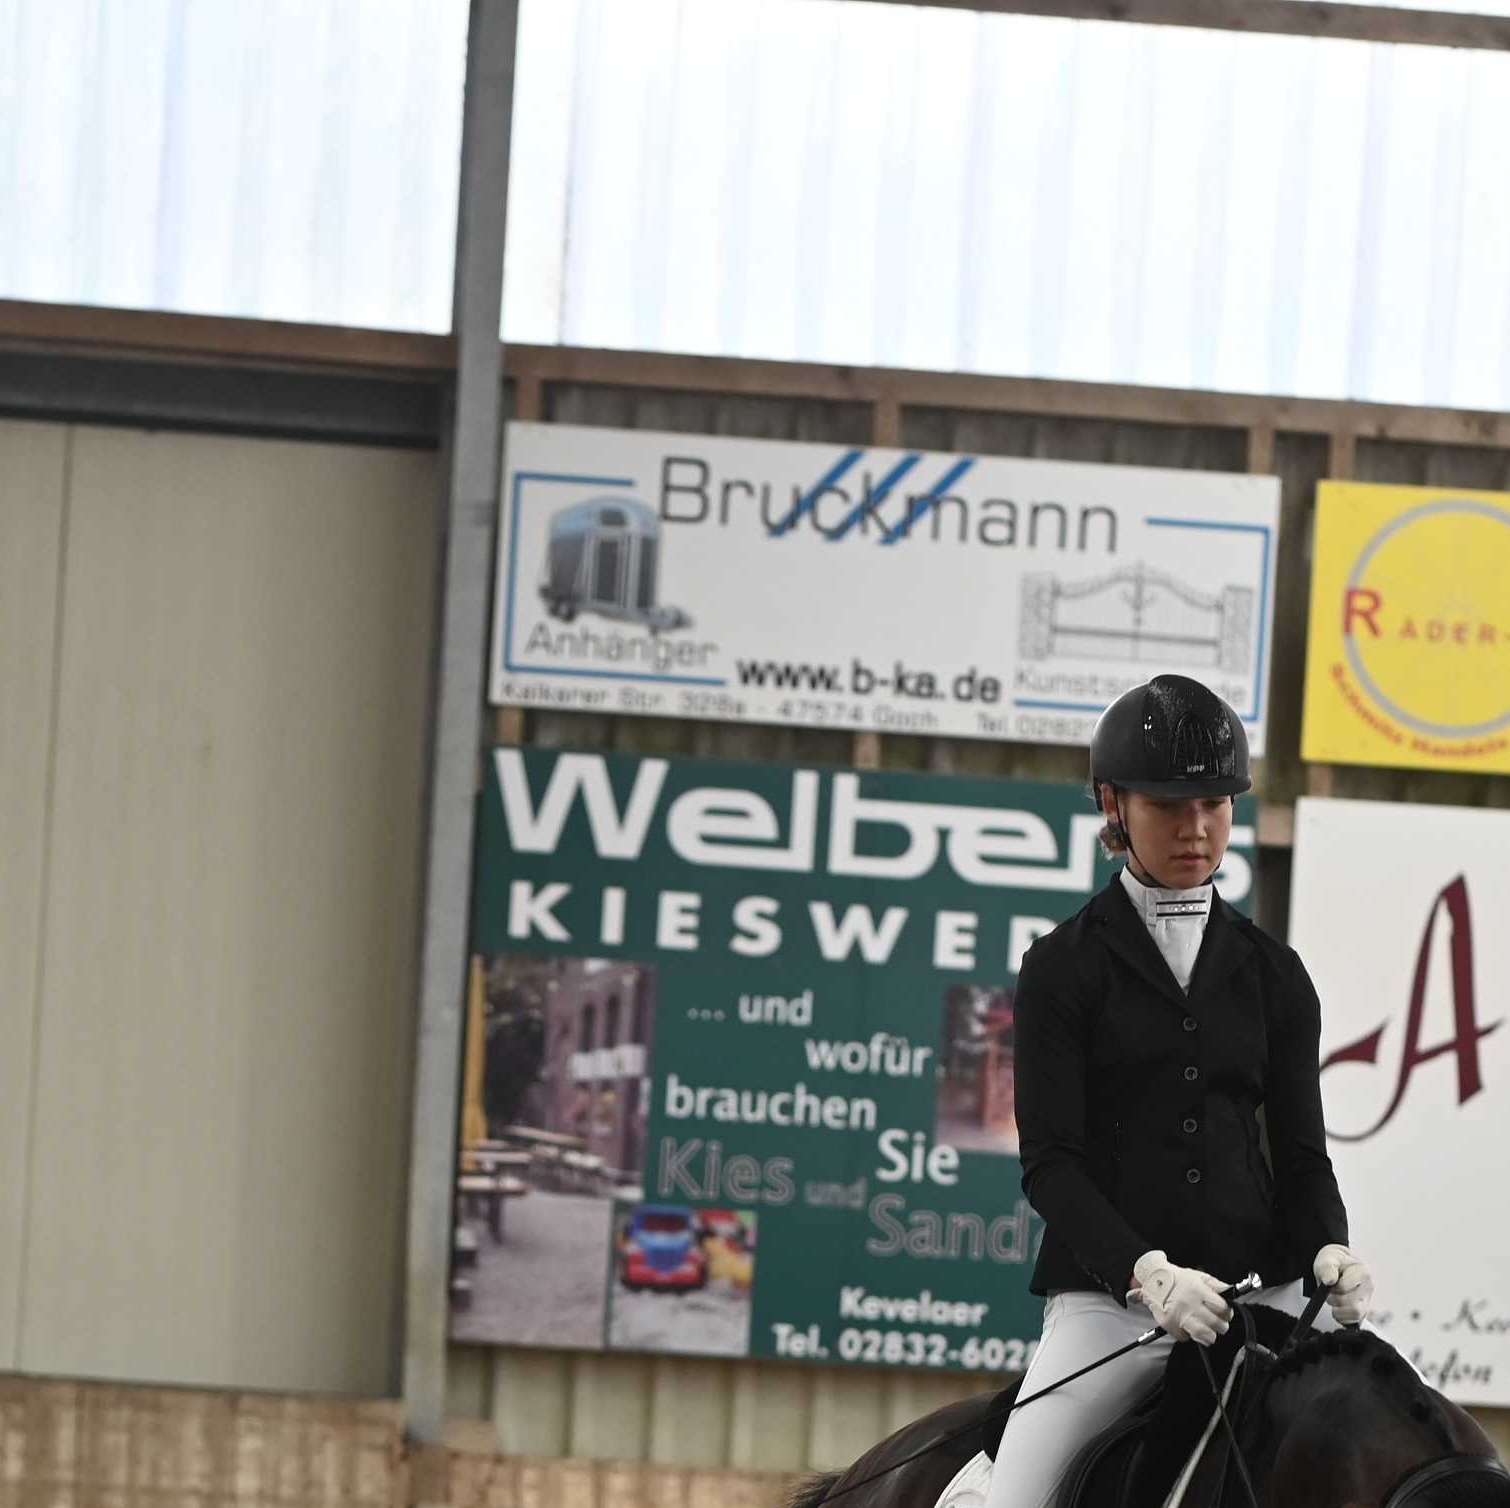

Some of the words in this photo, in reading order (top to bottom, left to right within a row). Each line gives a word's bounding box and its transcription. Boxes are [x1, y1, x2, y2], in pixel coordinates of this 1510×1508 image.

[660, 456, 1119, 554] Bruckmann
[525, 621, 720, 674] Anhänger
[736, 657, 1002, 704] www.b-ka.de
[507, 879, 1059, 976] KIESWE
[737, 989, 814, 1027] und
[803, 1031, 933, 1079] wofür
[665, 1073, 878, 1131] brauchen
[657, 1136, 796, 1206] Kies
[804, 1176, 868, 1208] und
[875, 1127, 960, 1186] Sie
[840, 1285, 989, 1327] Kevelaer
[771, 1322, 830, 1360] Tel.
